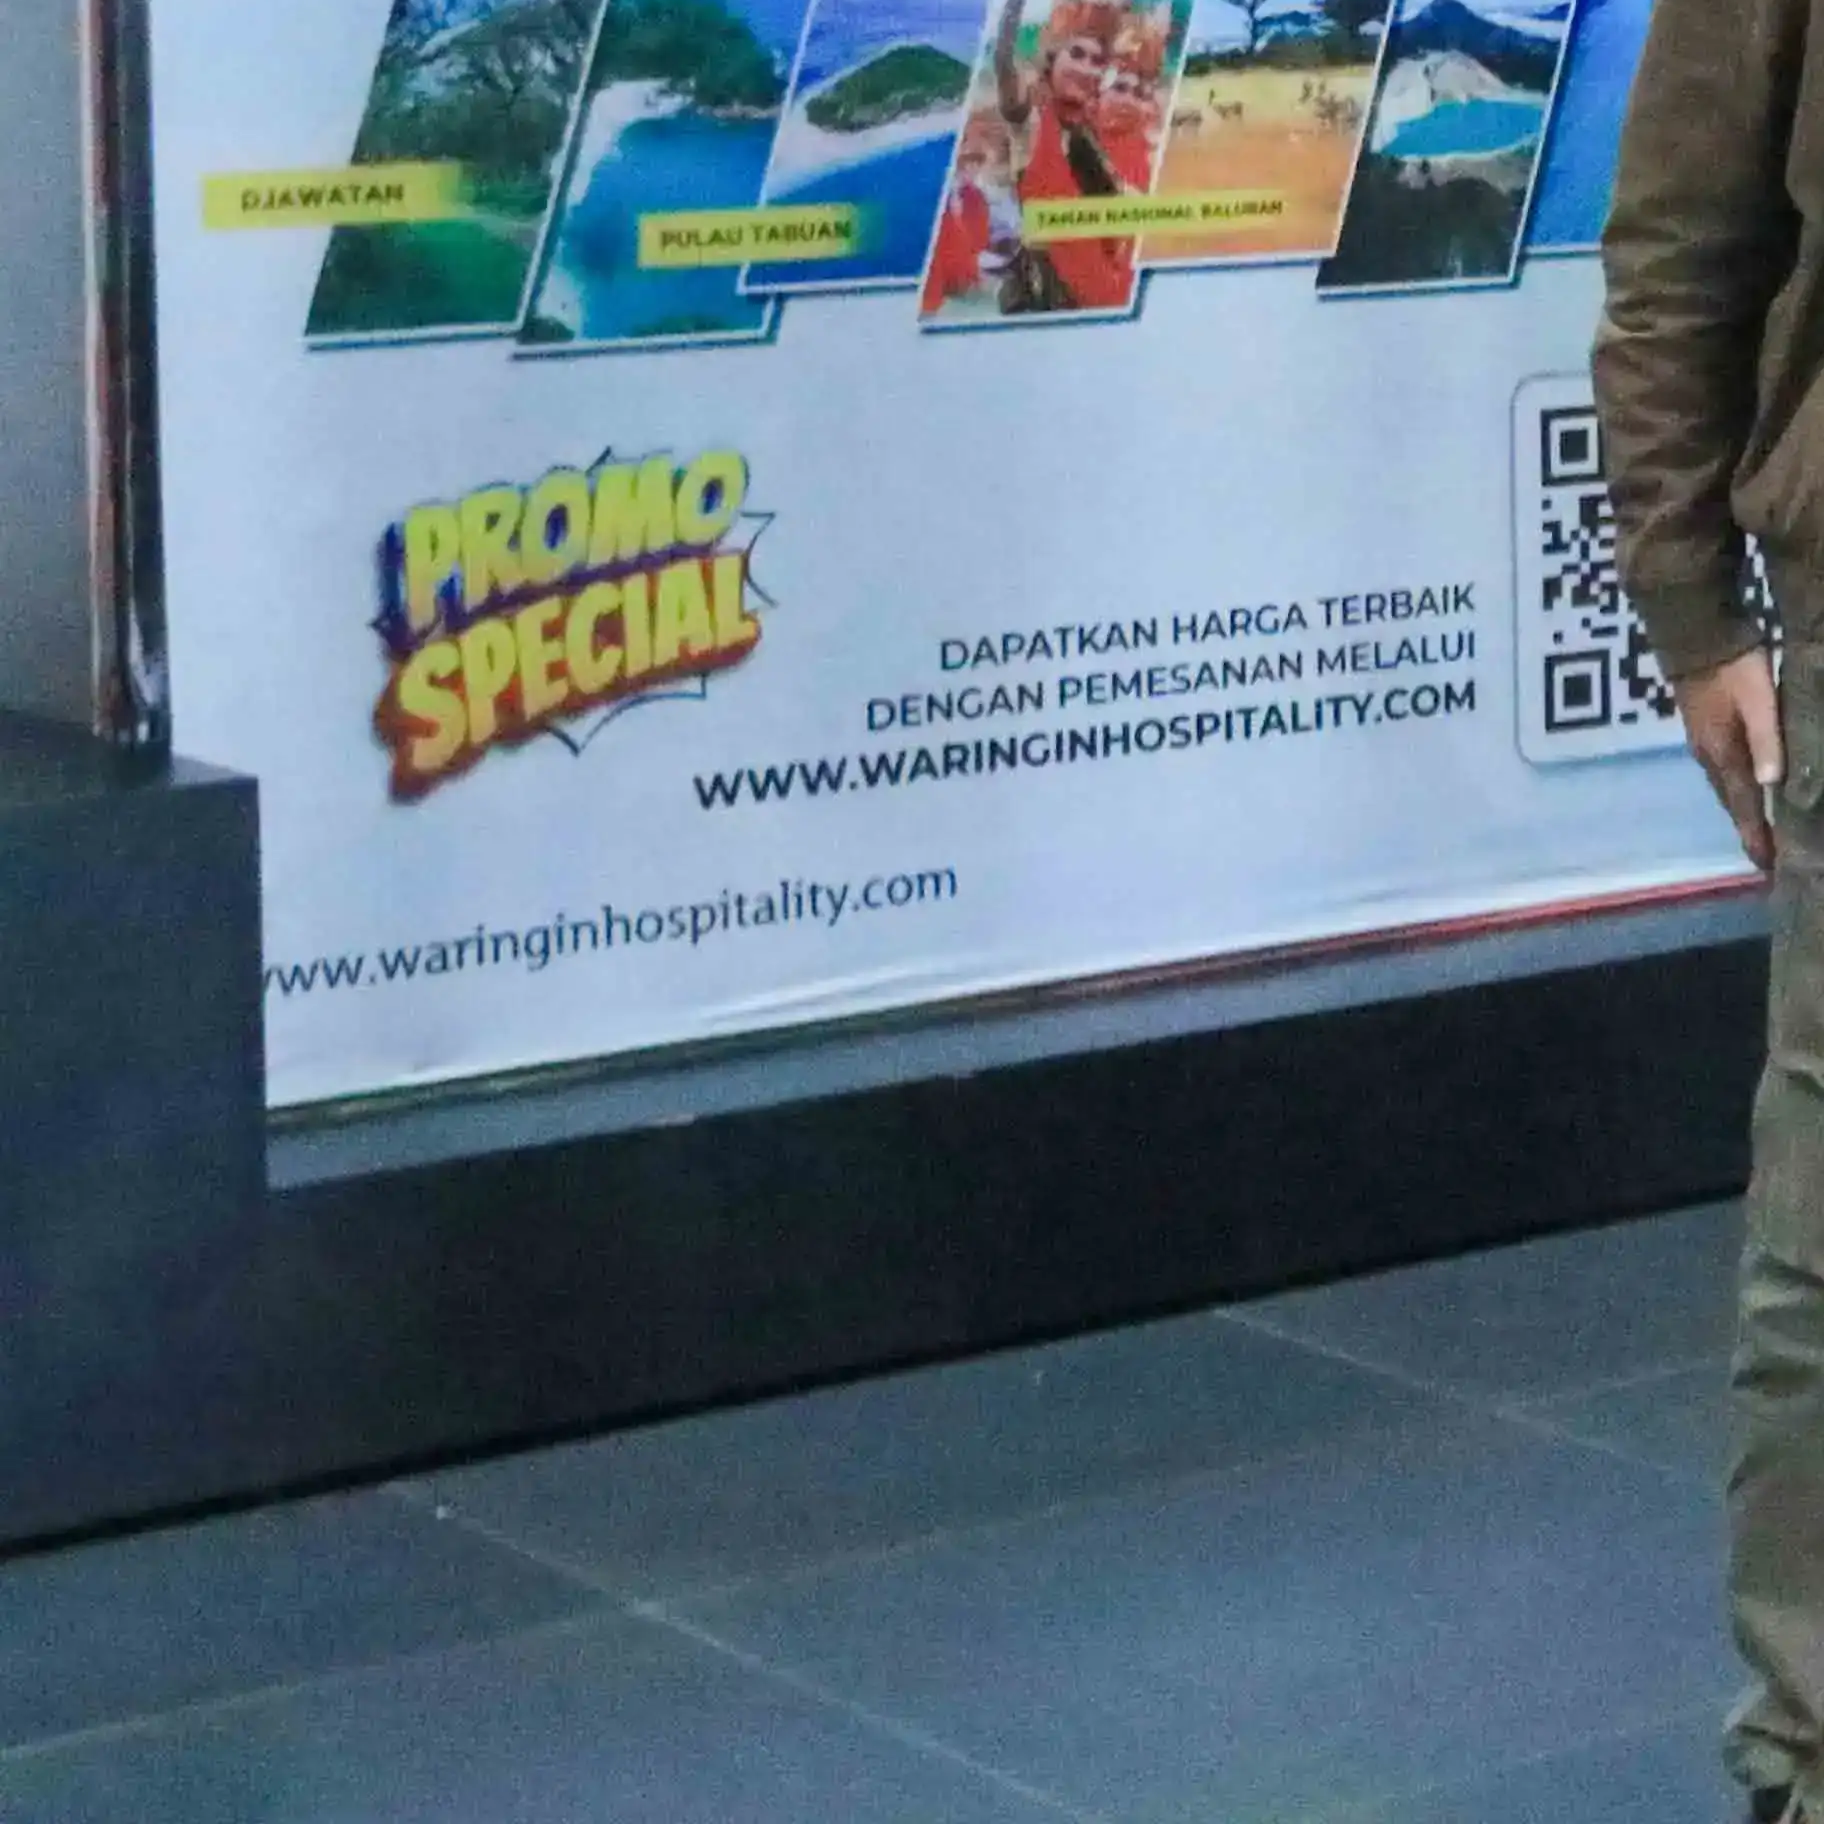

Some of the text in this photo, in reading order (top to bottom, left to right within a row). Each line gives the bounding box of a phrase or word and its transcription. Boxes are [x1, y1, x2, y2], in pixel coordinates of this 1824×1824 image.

[241, 182, 405, 212] DJAWATAN
[659, 227, 743, 252] PULAU
[1037, 206, 1100, 228] TAMAN
[1105, 205, 1192, 225] NASIONAL
[390, 449, 750, 629] PROMO
[394, 550, 760, 776] SPECIAL
[940, 582, 1476, 673] DAPATKAN HARGA TERBAIK
[866, 632, 1476, 733] DENGAN PEMESANAN MELALUI
[692, 678, 1477, 811] WWW.WARINGINHOSPITALITY.COM
[264, 864, 958, 997] ww.waringinhospitality.com
